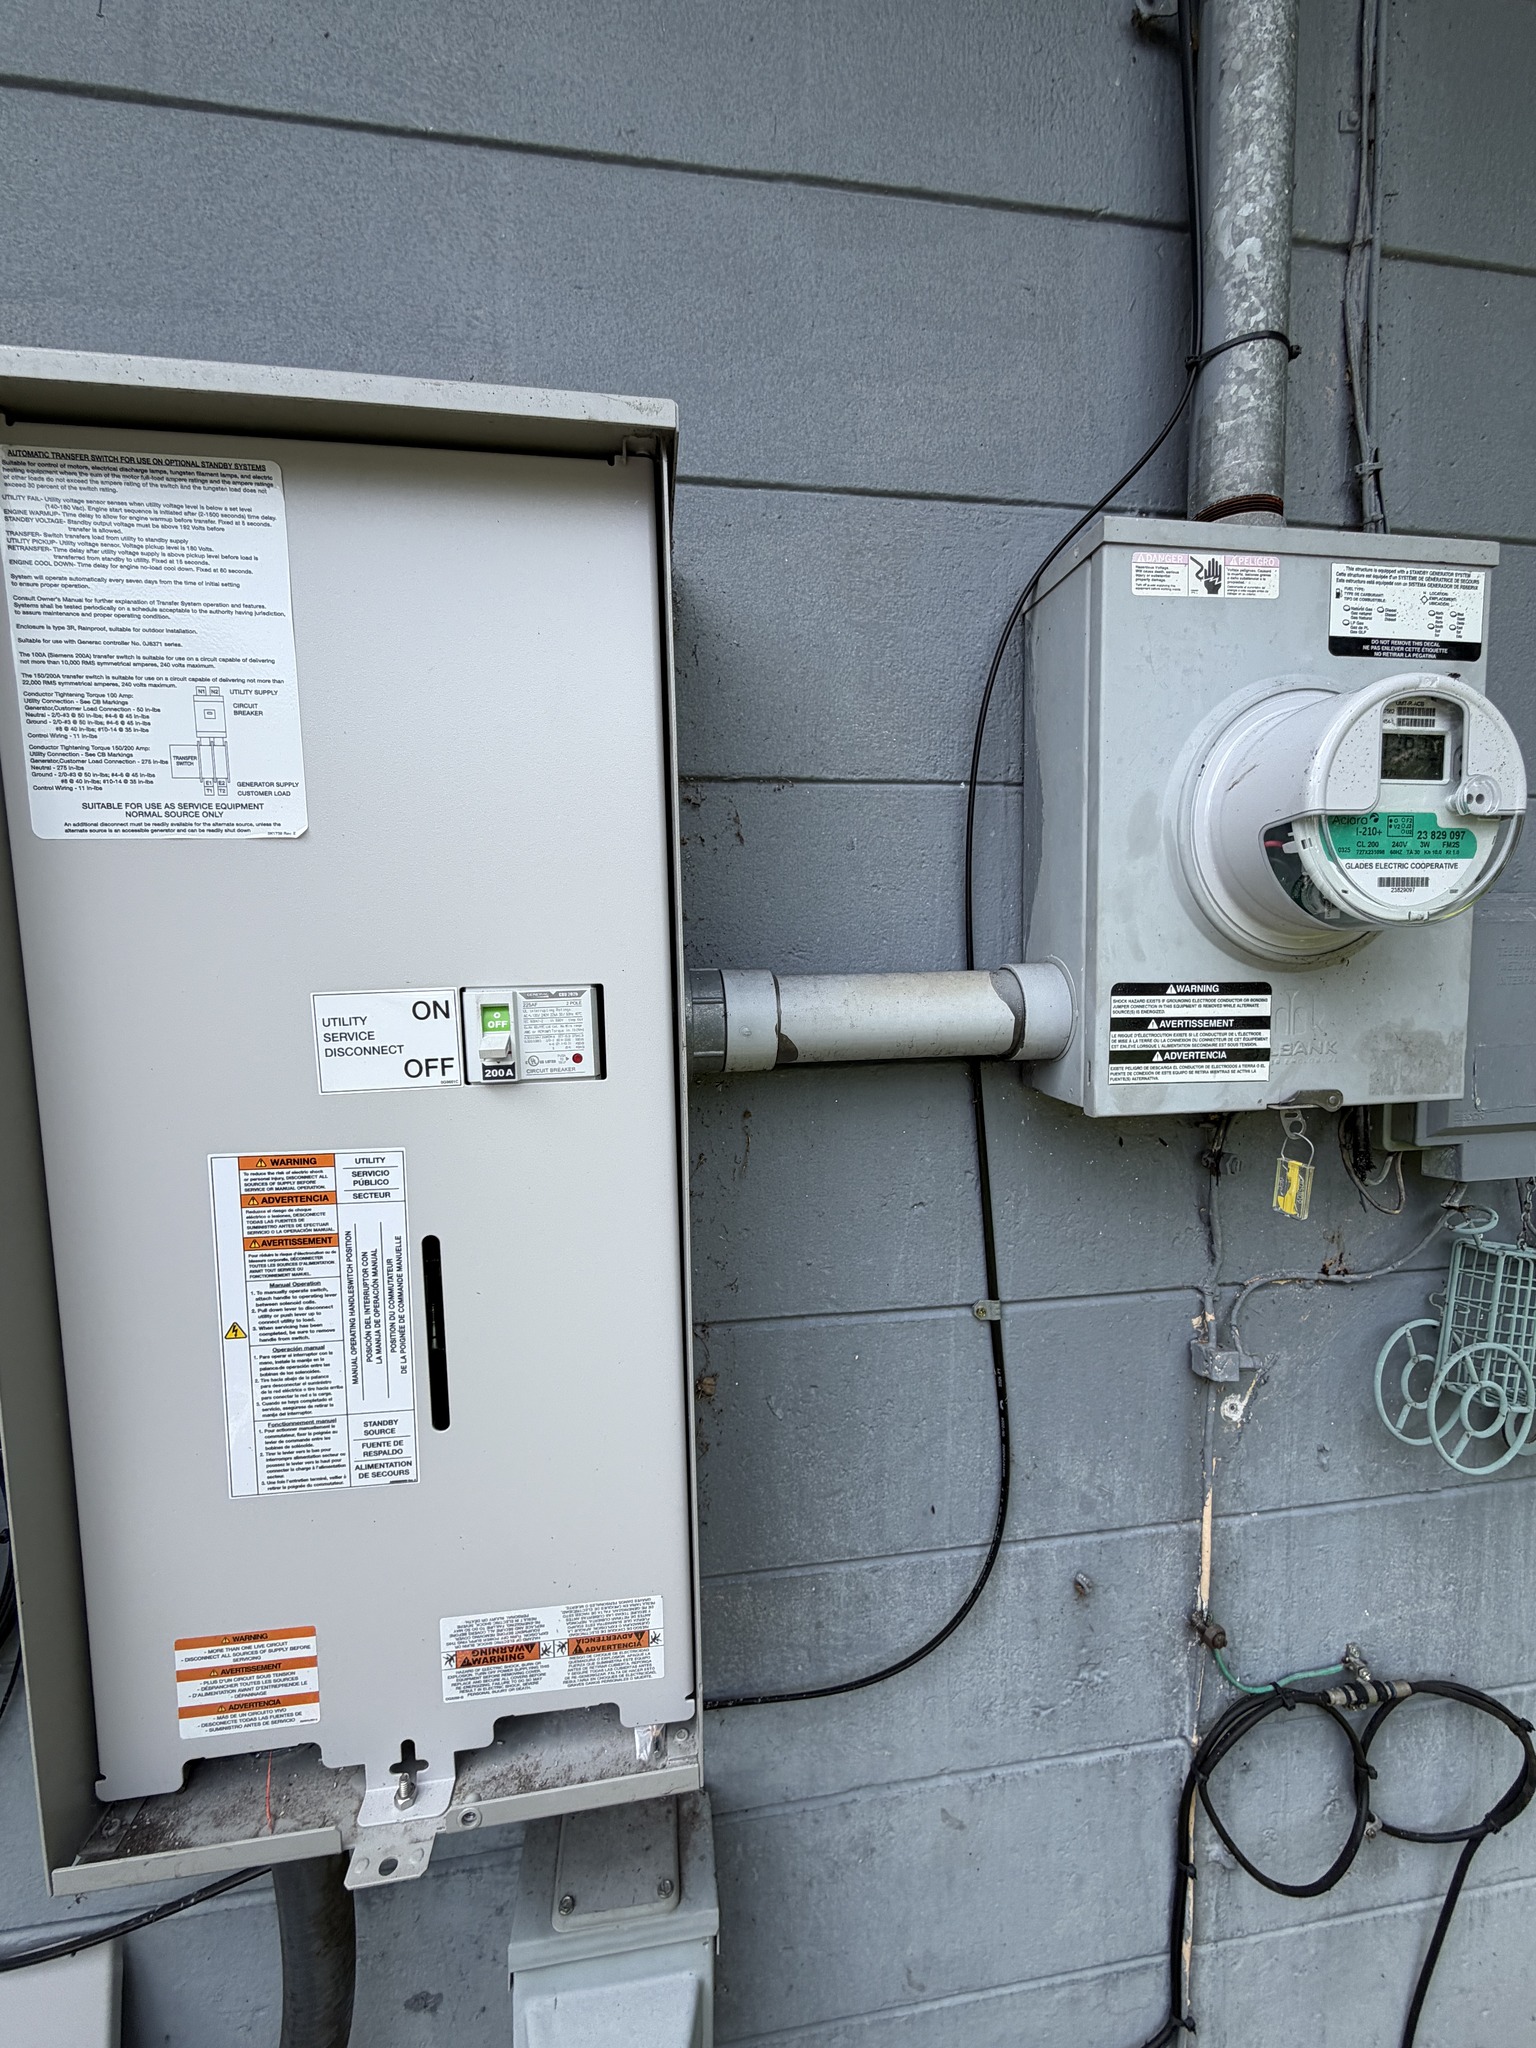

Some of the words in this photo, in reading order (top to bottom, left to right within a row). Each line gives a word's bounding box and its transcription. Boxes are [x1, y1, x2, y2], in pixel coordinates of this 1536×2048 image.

[7, 450, 49, 459] AUTOMATIC
[51, 452, 89, 461] TRANSFER
[90, 455, 118, 463] SWITCH
[164, 458, 199, 467] OPTIONAL
[200, 460, 232, 469] STANDBY
[233, 462, 267, 471] SYSTEMS
[1146, 555, 1183, 563] DANGER
[1332, 816, 1368, 825] Aclara
[1417, 831, 1428, 839] 23
[1431, 831, 1446, 839] 829
[1450, 831, 1465, 839] 097
[1177, 985, 1219, 993] WARNING
[412, 1000, 450, 1020] ON
[322, 1016, 368, 1028] UTILITY
[1160, 1019, 1234, 1027] AVERTISSEMENT
[323, 1031, 375, 1043] SERVICE
[324, 1045, 404, 1058] DISCONNECT
[1164, 1051, 1227, 1059] ADVERTENCIA
[404, 1057, 454, 1079] OFF
[270, 1158, 317, 1166] WARNING
[353, 1178, 389, 1186] PÚBLICO
[261, 1195, 329, 1205] ADVERTENCIA
[261, 1237, 332, 1247] AVERTISSEMENT
[395, 1235, 403, 1271] MANUELLE
[387, 1259, 395, 1309] COMMUTATEUR
[363, 1267, 371, 1314] INTERRUPTOR
[371, 1278, 380, 1317] OPERACIÓN
[389, 1310, 396, 1320] DU
[398, 1314, 405, 1323] DE
[374, 1318, 380, 1328] DE
[349, 1317, 357, 1355] OPERATING
[398, 1324, 406, 1353] POIGNÉE
[272, 1345, 302, 1353] Operación
[364, 1330, 372, 1362] POSICIÓN
[375, 1355, 382, 1364] LA
[400, 1355, 407, 1363] LA
[401, 1364, 407, 1374] DE
[268, 1419, 314, 1427] Fonctionnement
[363, 1419, 398, 1427] STANDBY
[363, 1449, 403, 1457] RESPALDO
[355, 1461, 412, 1470] ALIMENTATION
[372, 1469, 409, 1478] SECOURS
[232, 1634, 268, 1642] WARNING
[576, 1633, 633, 1644] ADVERTENCIA
[472, 1644, 525, 1656] WARNING
[585, 1642, 641, 1652] ADVERTENCIA
[185, 1654, 219, 1662] DISCONNECT
[472, 1653, 524, 1665] WARNING
[221, 1663, 281, 1675] AVERTISSEMENT
[229, 1699, 281, 1710] ADVERTENCIA
